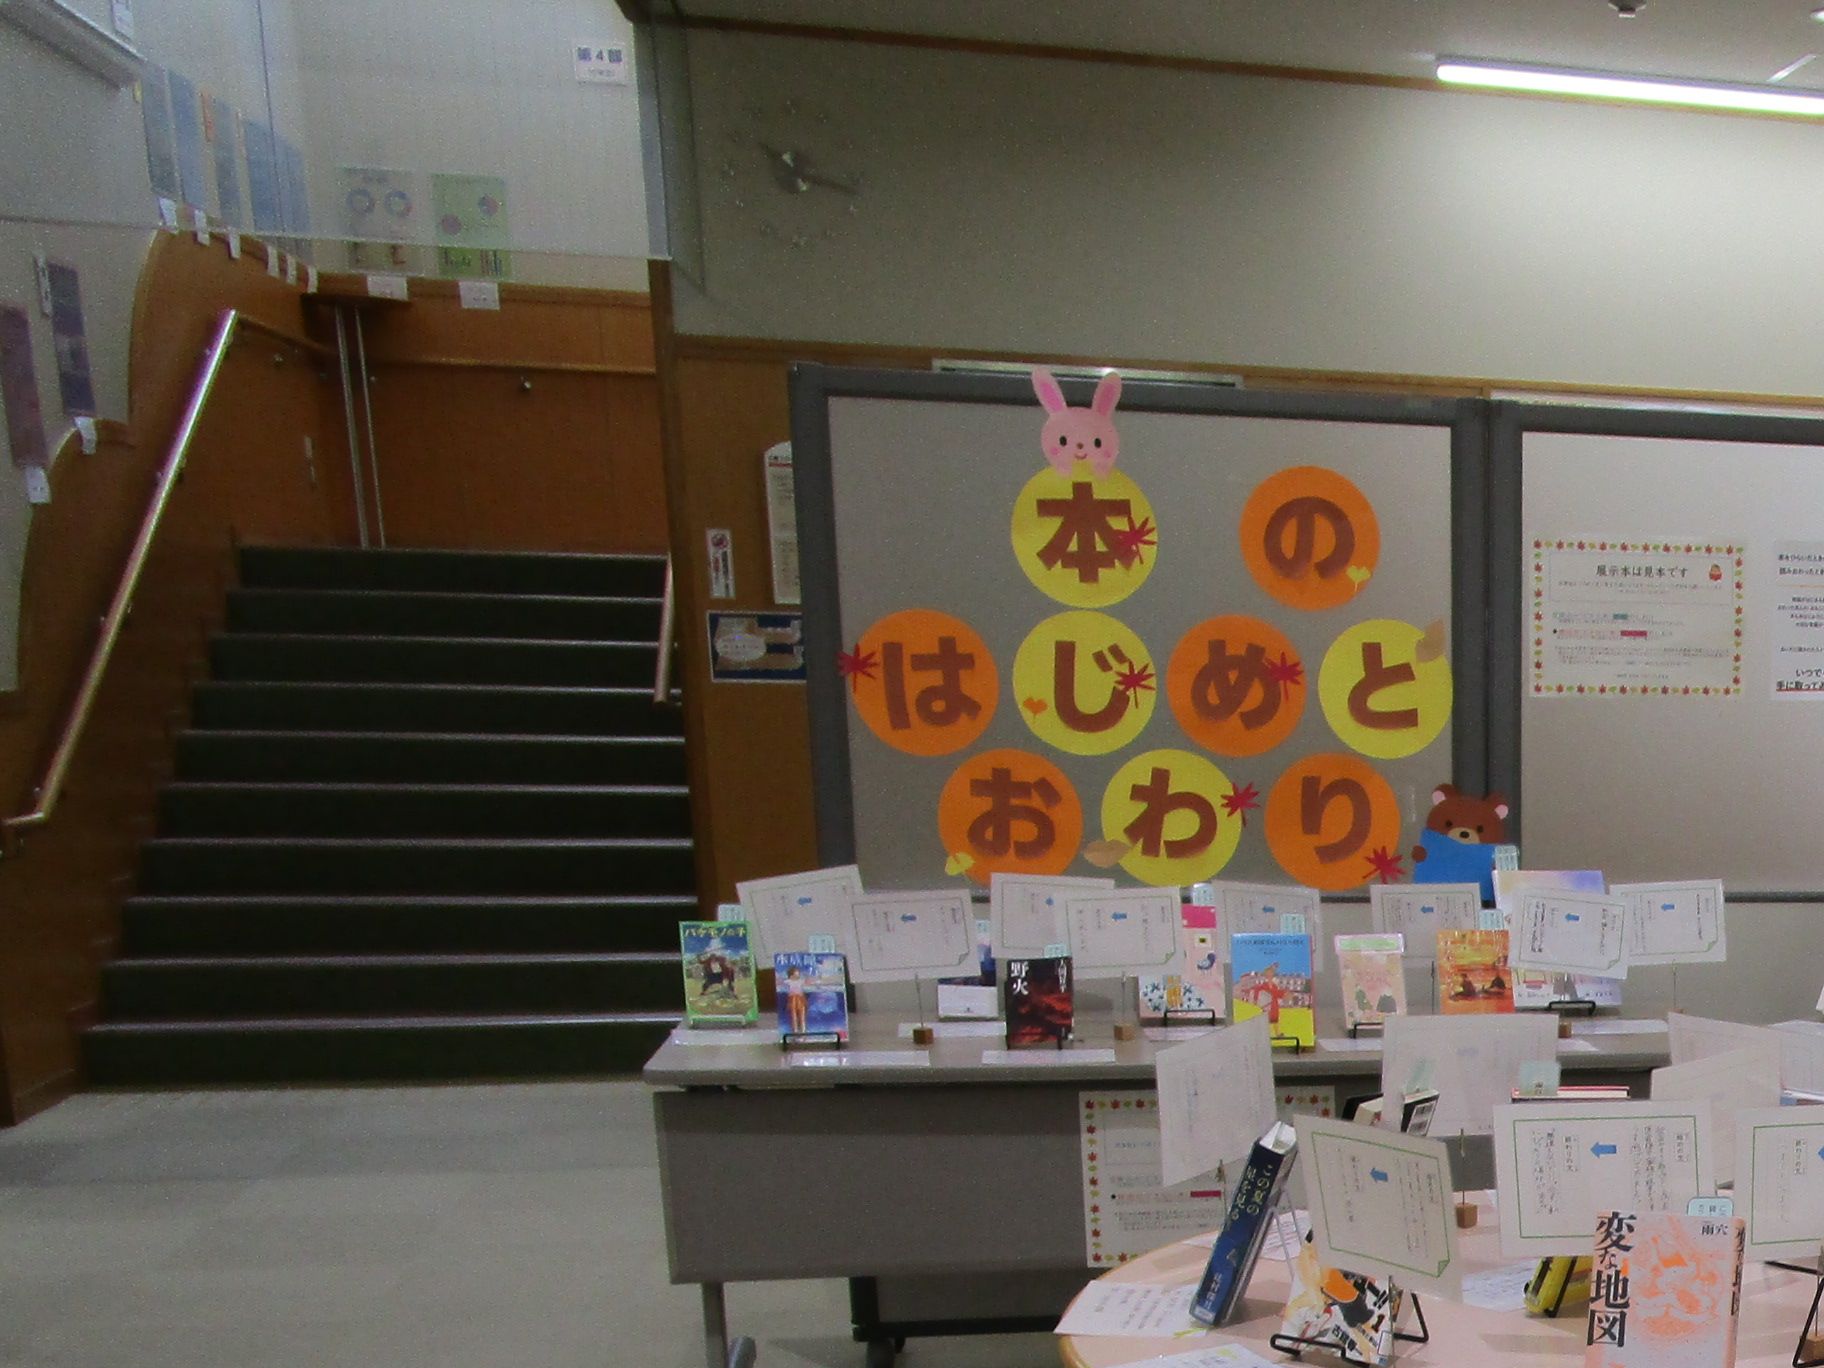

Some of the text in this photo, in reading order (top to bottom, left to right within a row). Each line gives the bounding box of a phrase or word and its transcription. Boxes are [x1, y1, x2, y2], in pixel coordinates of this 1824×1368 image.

[1596, 564, 1688, 578] 展示本は見本です
[1011, 961, 1029, 995] 野火
[1701, 1222, 1728, 1236] 雨穴
[1587, 1211, 1637, 1348] 変な地図
